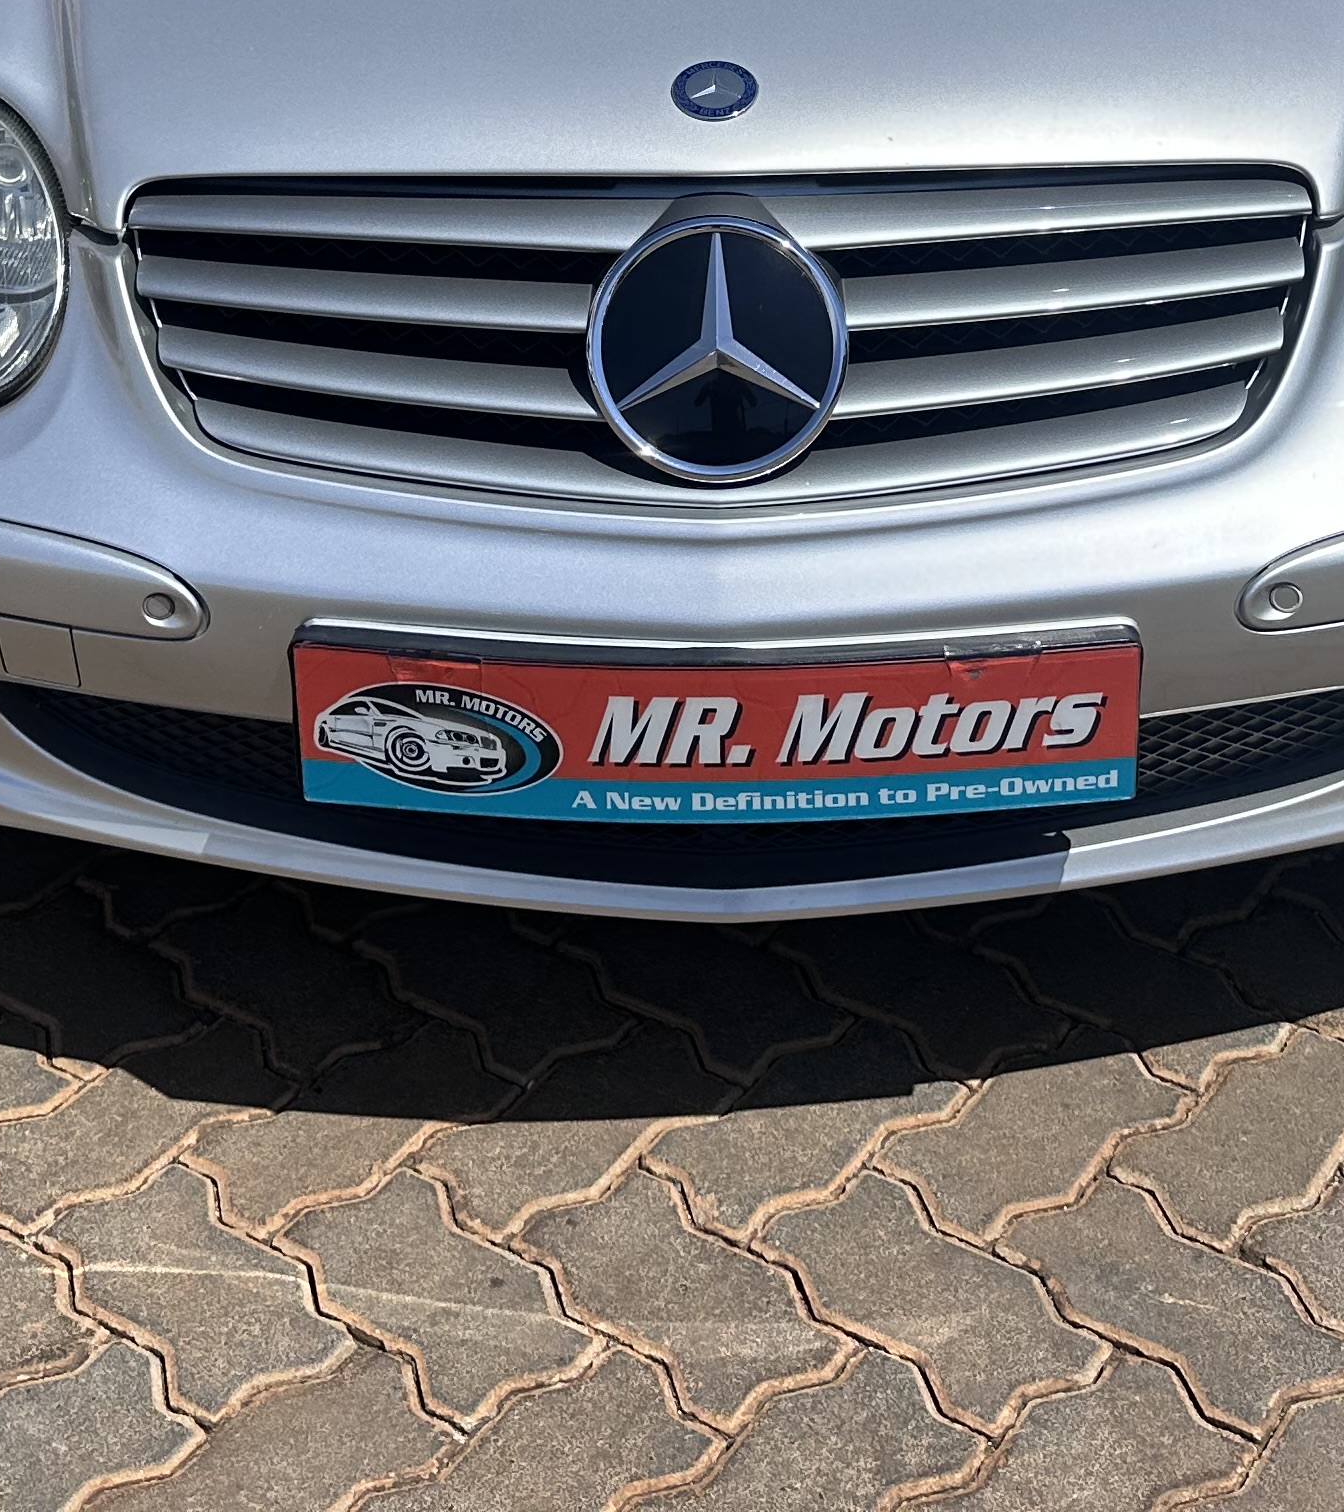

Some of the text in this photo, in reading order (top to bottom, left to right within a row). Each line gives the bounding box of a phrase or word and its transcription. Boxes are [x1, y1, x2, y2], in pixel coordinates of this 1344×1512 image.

[415, 689, 548, 743] MR. MOTORS
[587, 690, 1105, 765] MR. Motors
[571, 769, 1119, 811] A New Definition to Pre-Owned
